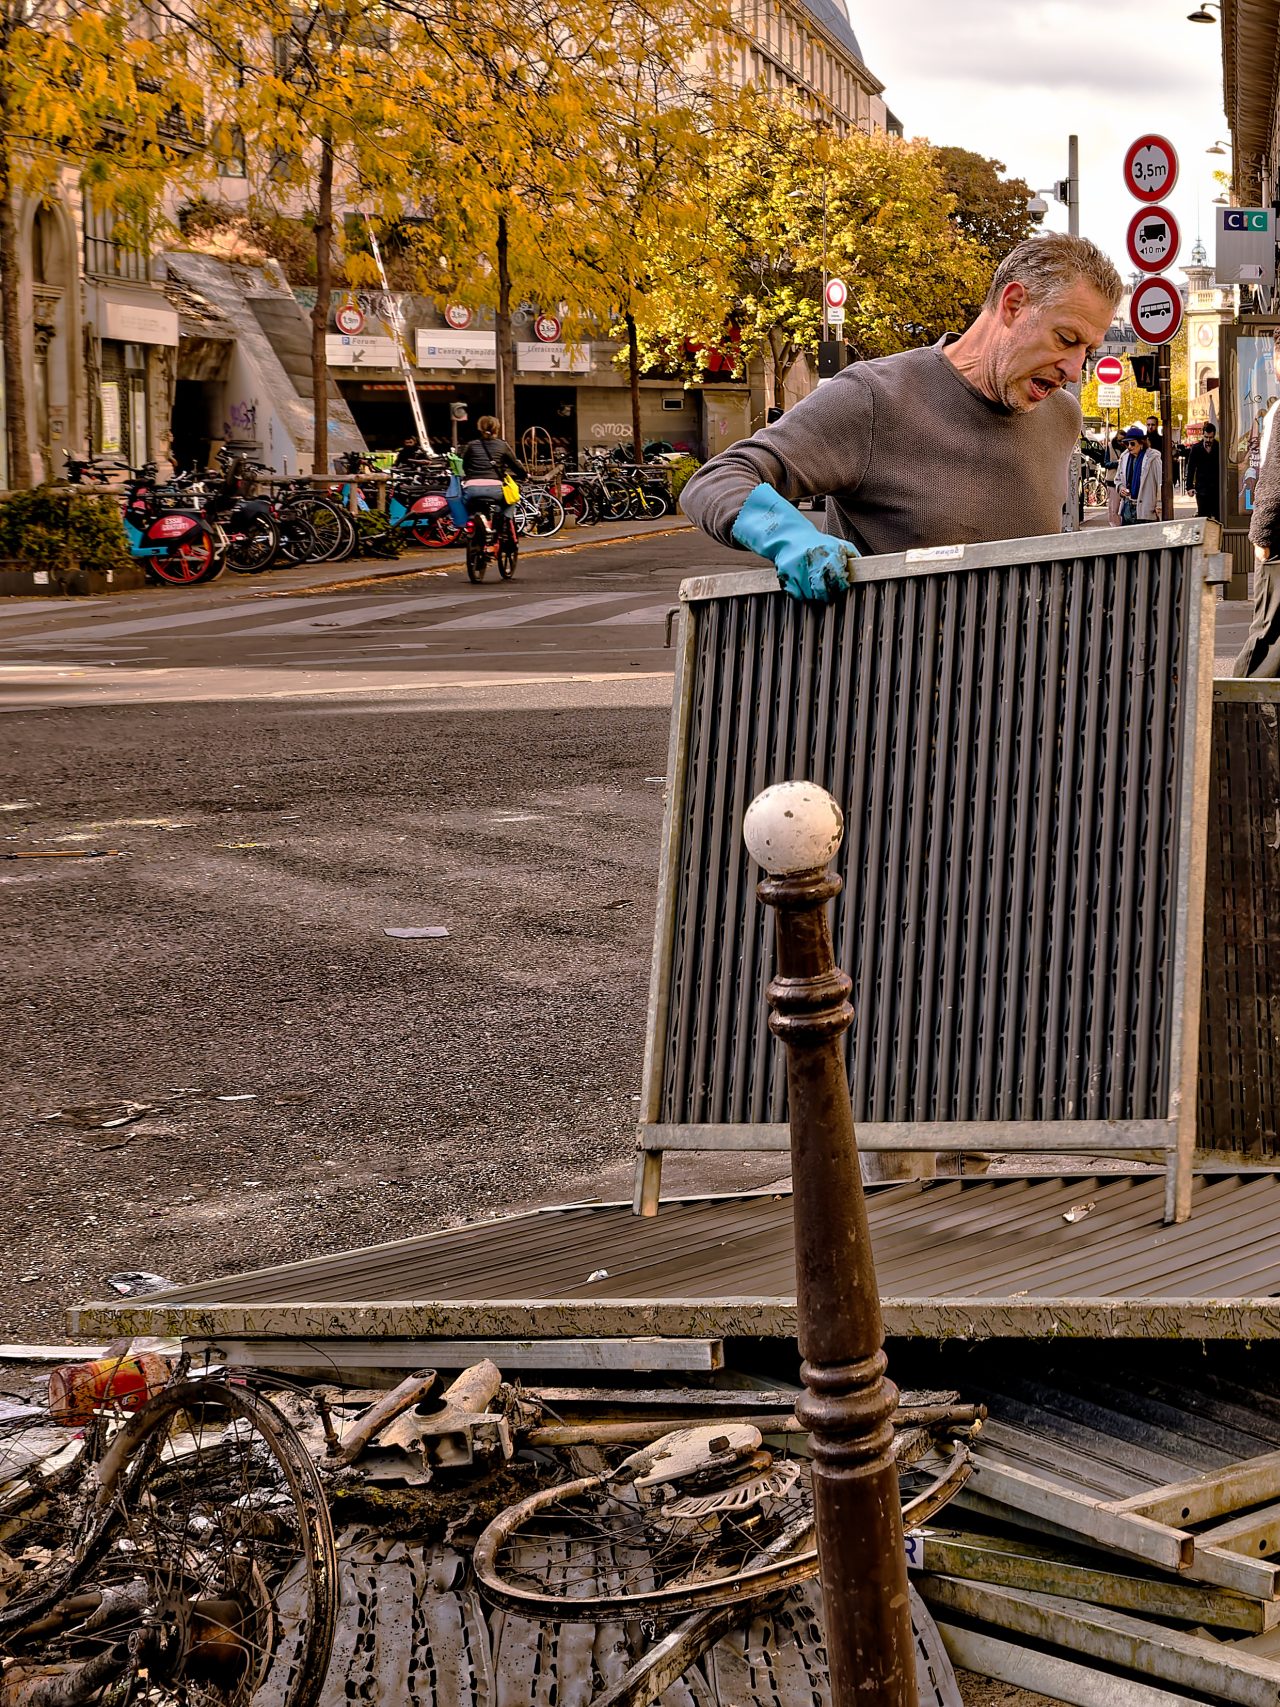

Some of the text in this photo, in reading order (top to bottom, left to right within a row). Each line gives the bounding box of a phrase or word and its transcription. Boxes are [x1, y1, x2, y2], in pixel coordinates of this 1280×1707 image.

[1134, 162, 1166, 180] 3,5m
[1228, 214, 1264, 228] CIC
[1144, 246, 1153, 254] 10
[352, 338, 376, 346] Forum
[465, 348, 496, 357] Pompido
